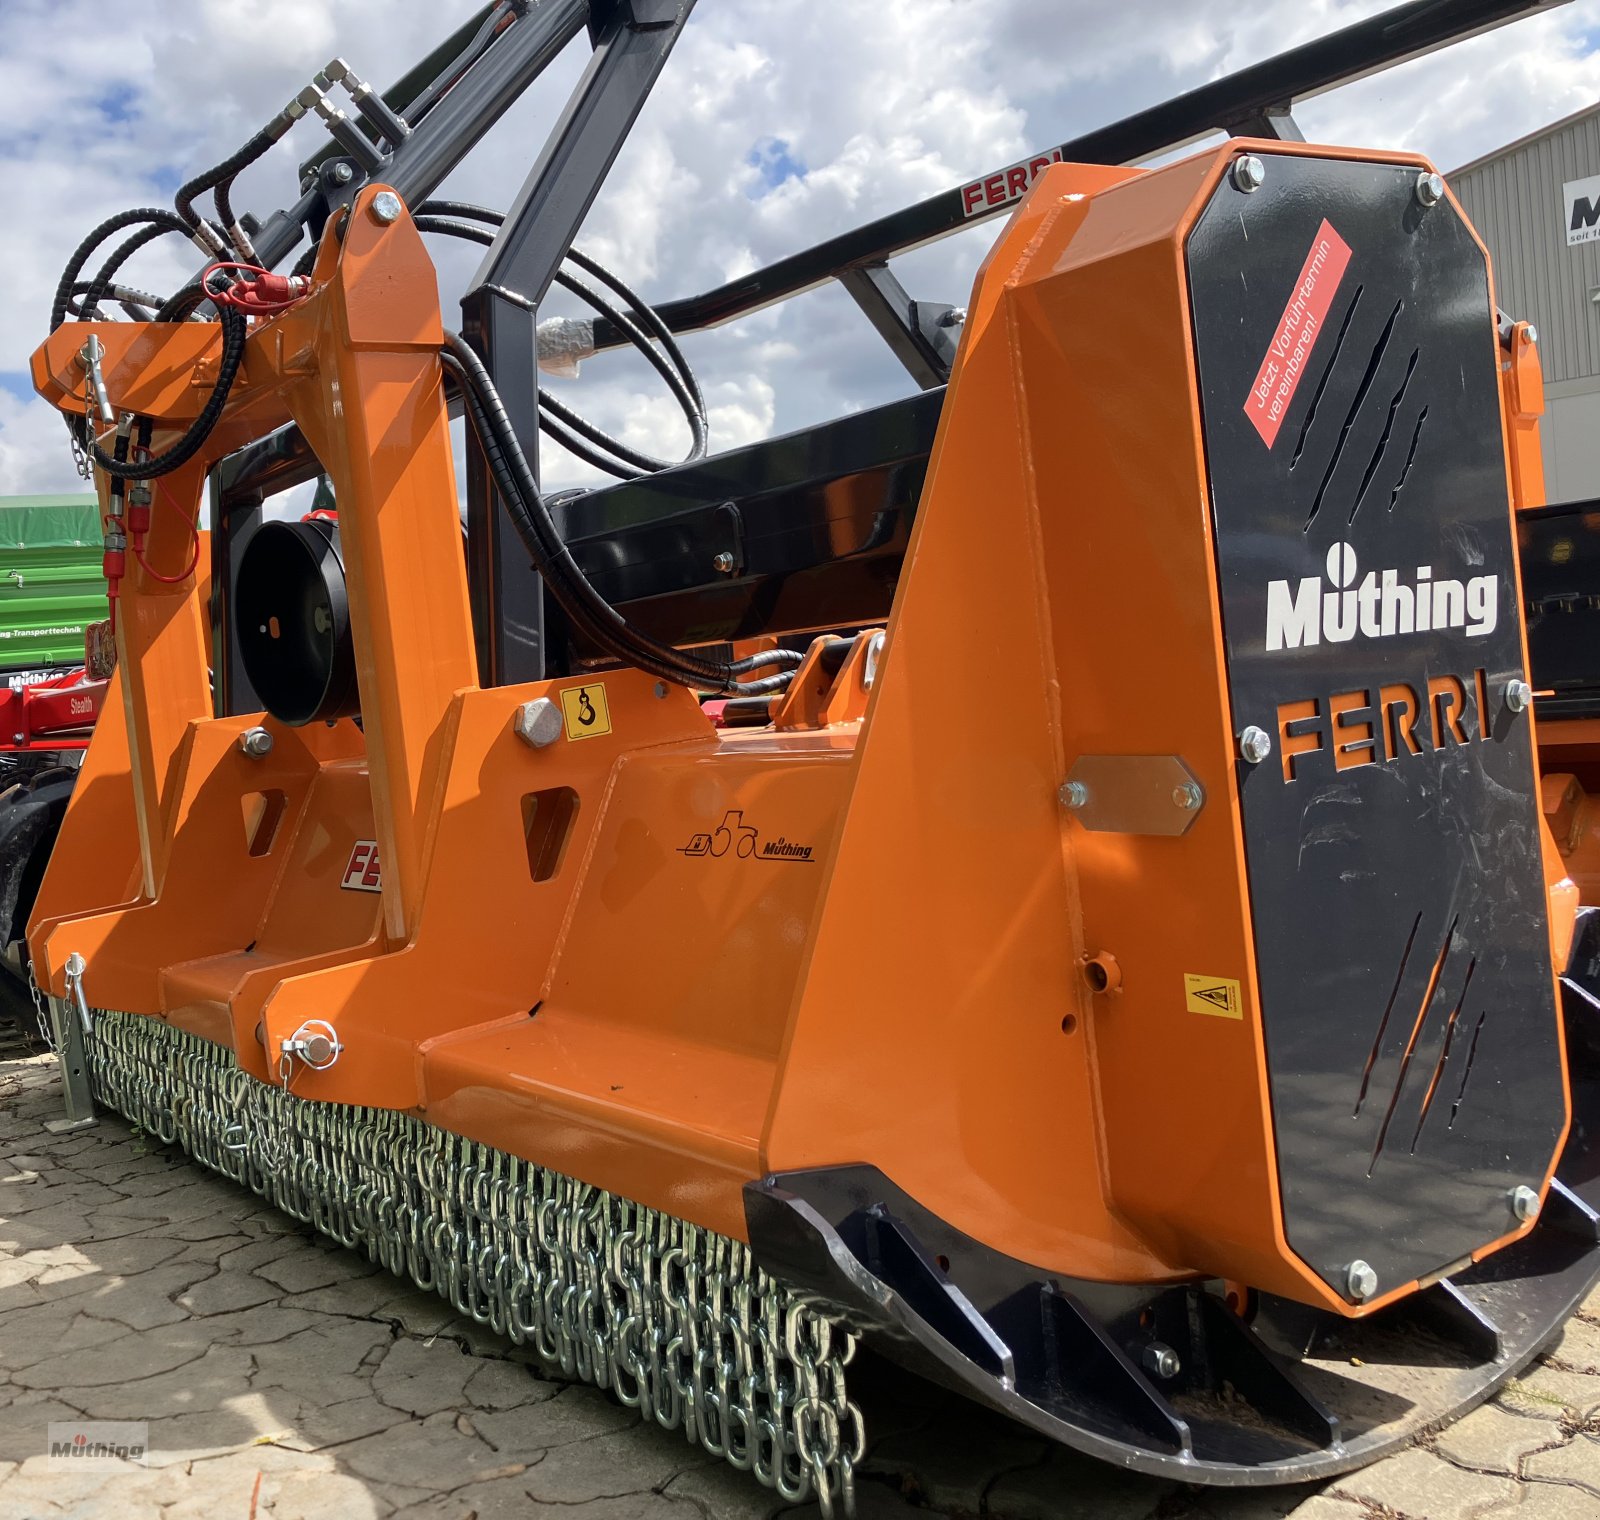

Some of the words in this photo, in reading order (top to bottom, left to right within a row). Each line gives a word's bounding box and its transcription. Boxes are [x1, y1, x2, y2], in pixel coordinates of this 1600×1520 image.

[1570, 231, 1589, 242] seit
[1254, 362, 1279, 409] Jetzt
[1272, 240, 1331, 358] Vorführtermin
[1267, 311, 1318, 422] vereinbaren!
[1266, 541, 1498, 651] Müthing
[70, 695, 93, 715] Stealth
[1277, 667, 1492, 784] FERRI
[344, 845, 382, 887] FE
[763, 837, 813, 859] Müthing
